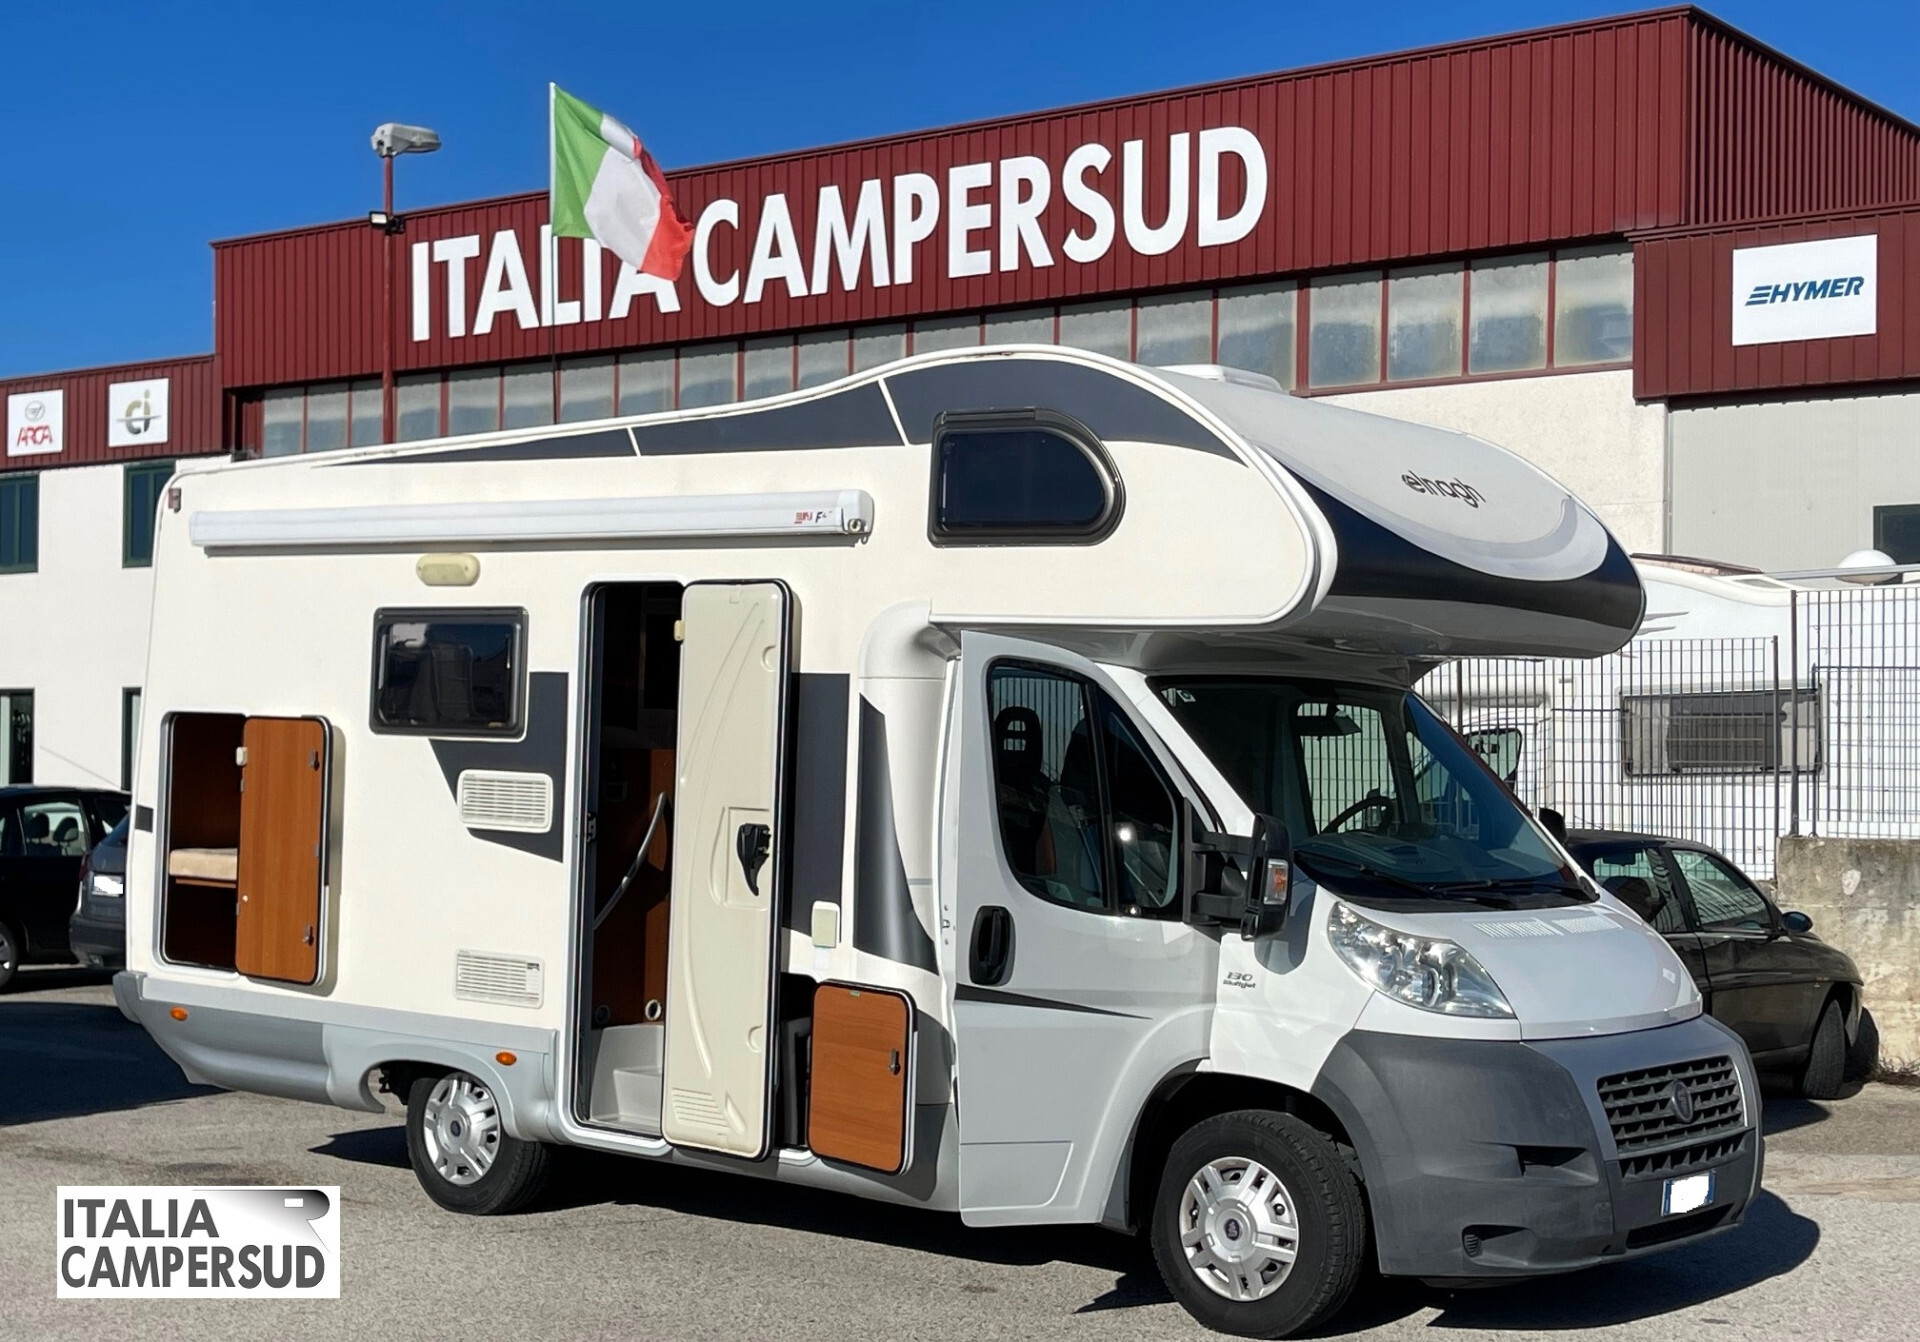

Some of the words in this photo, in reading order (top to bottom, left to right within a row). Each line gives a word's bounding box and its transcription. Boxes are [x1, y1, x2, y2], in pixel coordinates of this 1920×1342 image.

[412, 224, 681, 342] ITALIA
[693, 126, 1268, 306] CAMPERSUD
[1768, 276, 1865, 304] HYMER
[17, 425, 52, 446] ARCA
[1401, 469, 1487, 508] elnagh
